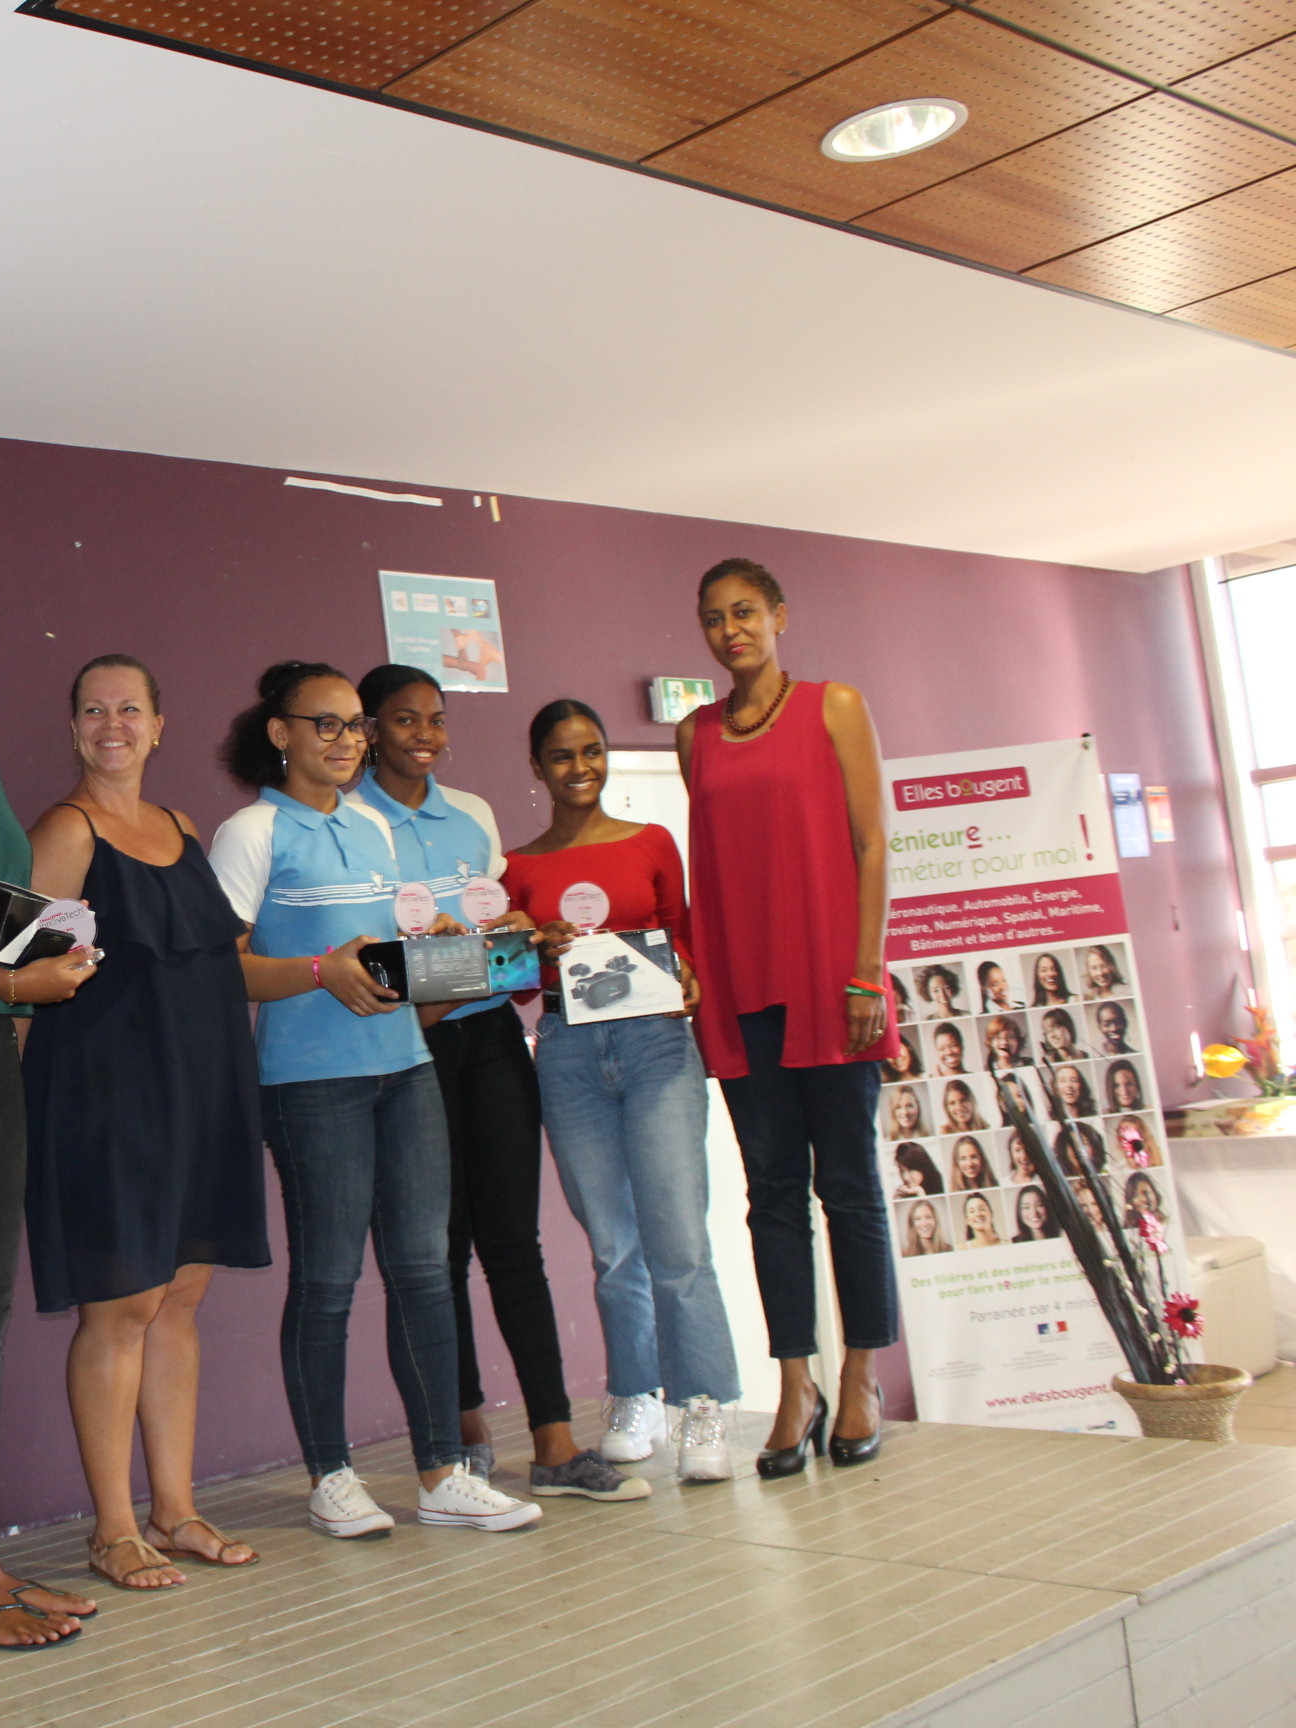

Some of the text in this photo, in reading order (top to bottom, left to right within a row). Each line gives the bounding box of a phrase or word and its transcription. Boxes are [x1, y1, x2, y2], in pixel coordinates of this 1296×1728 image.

[902, 775, 1025, 803] Elles bougent
[892, 857, 965, 883] métier
[972, 853, 1027, 879] pour
[1032, 841, 1078, 867] moi
[963, 894, 1032, 911] Automobile,
[1032, 888, 1083, 902] Énergie,
[933, 916, 1002, 931] Numérique,
[1002, 909, 1048, 925] Spatial,
[1048, 904, 1105, 918] Maritime,
[910, 936, 964, 952] Bâtiment
[964, 935, 978, 945] et
[978, 932, 1005, 943] bien
[1029, 1303, 1049, 1316] par
